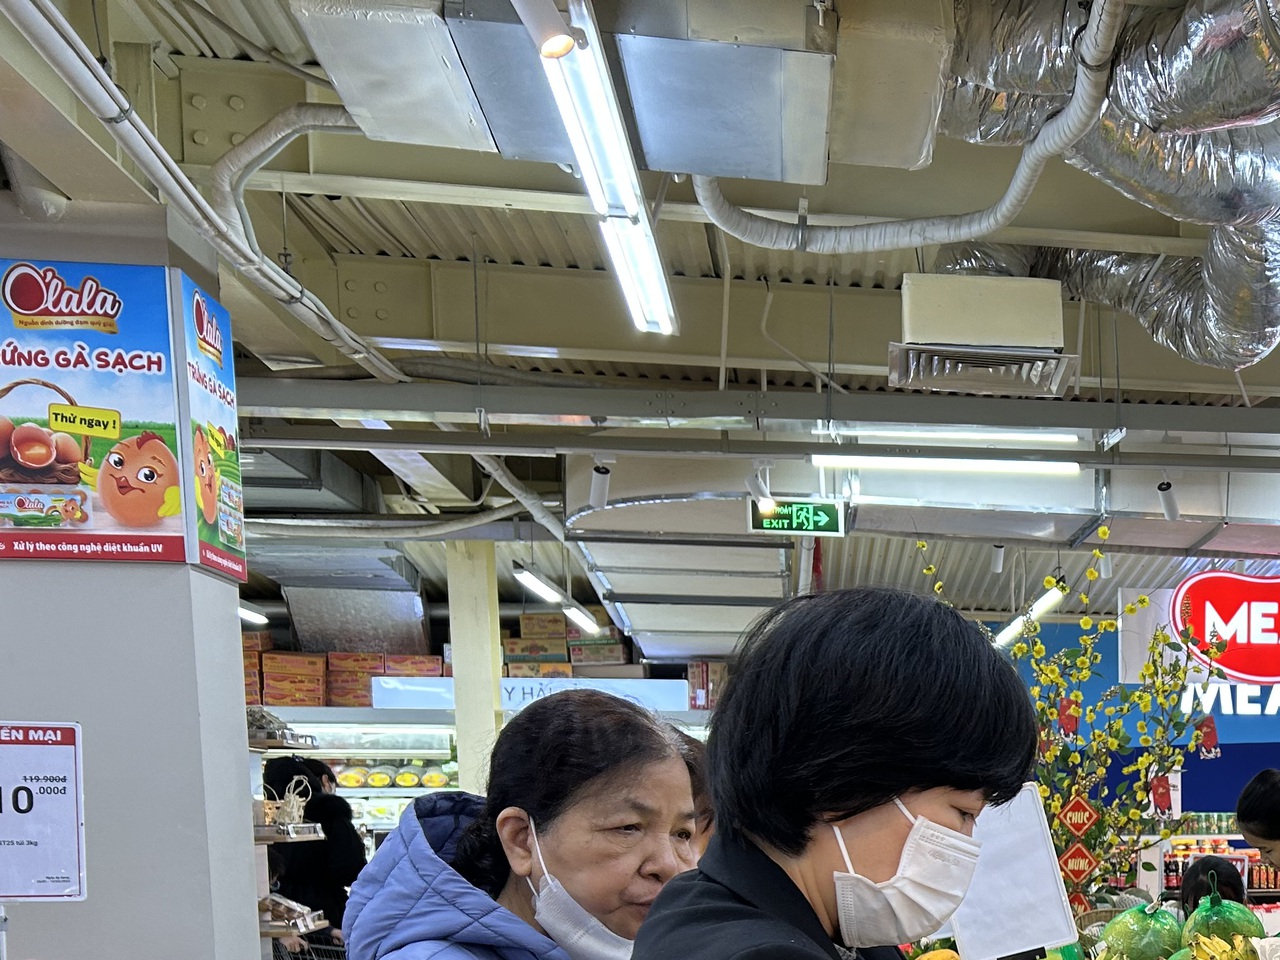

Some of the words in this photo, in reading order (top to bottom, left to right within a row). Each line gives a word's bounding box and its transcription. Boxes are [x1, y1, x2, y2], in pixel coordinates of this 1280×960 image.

[55, 344, 90, 368] GÀ
[95, 350, 162, 373] SẠCH
[52, 412, 77, 424] Thử
[79, 417, 109, 430] ngay
[763, 519, 790, 529] EXIT
[36, 542, 56, 550] theo
[58, 542, 78, 553] công
[151, 543, 162, 553] UV
[29, 729, 62, 744] MẠI
[1066, 809, 1090, 824] CHÚC
[1067, 855, 1090, 870] MỪNG
